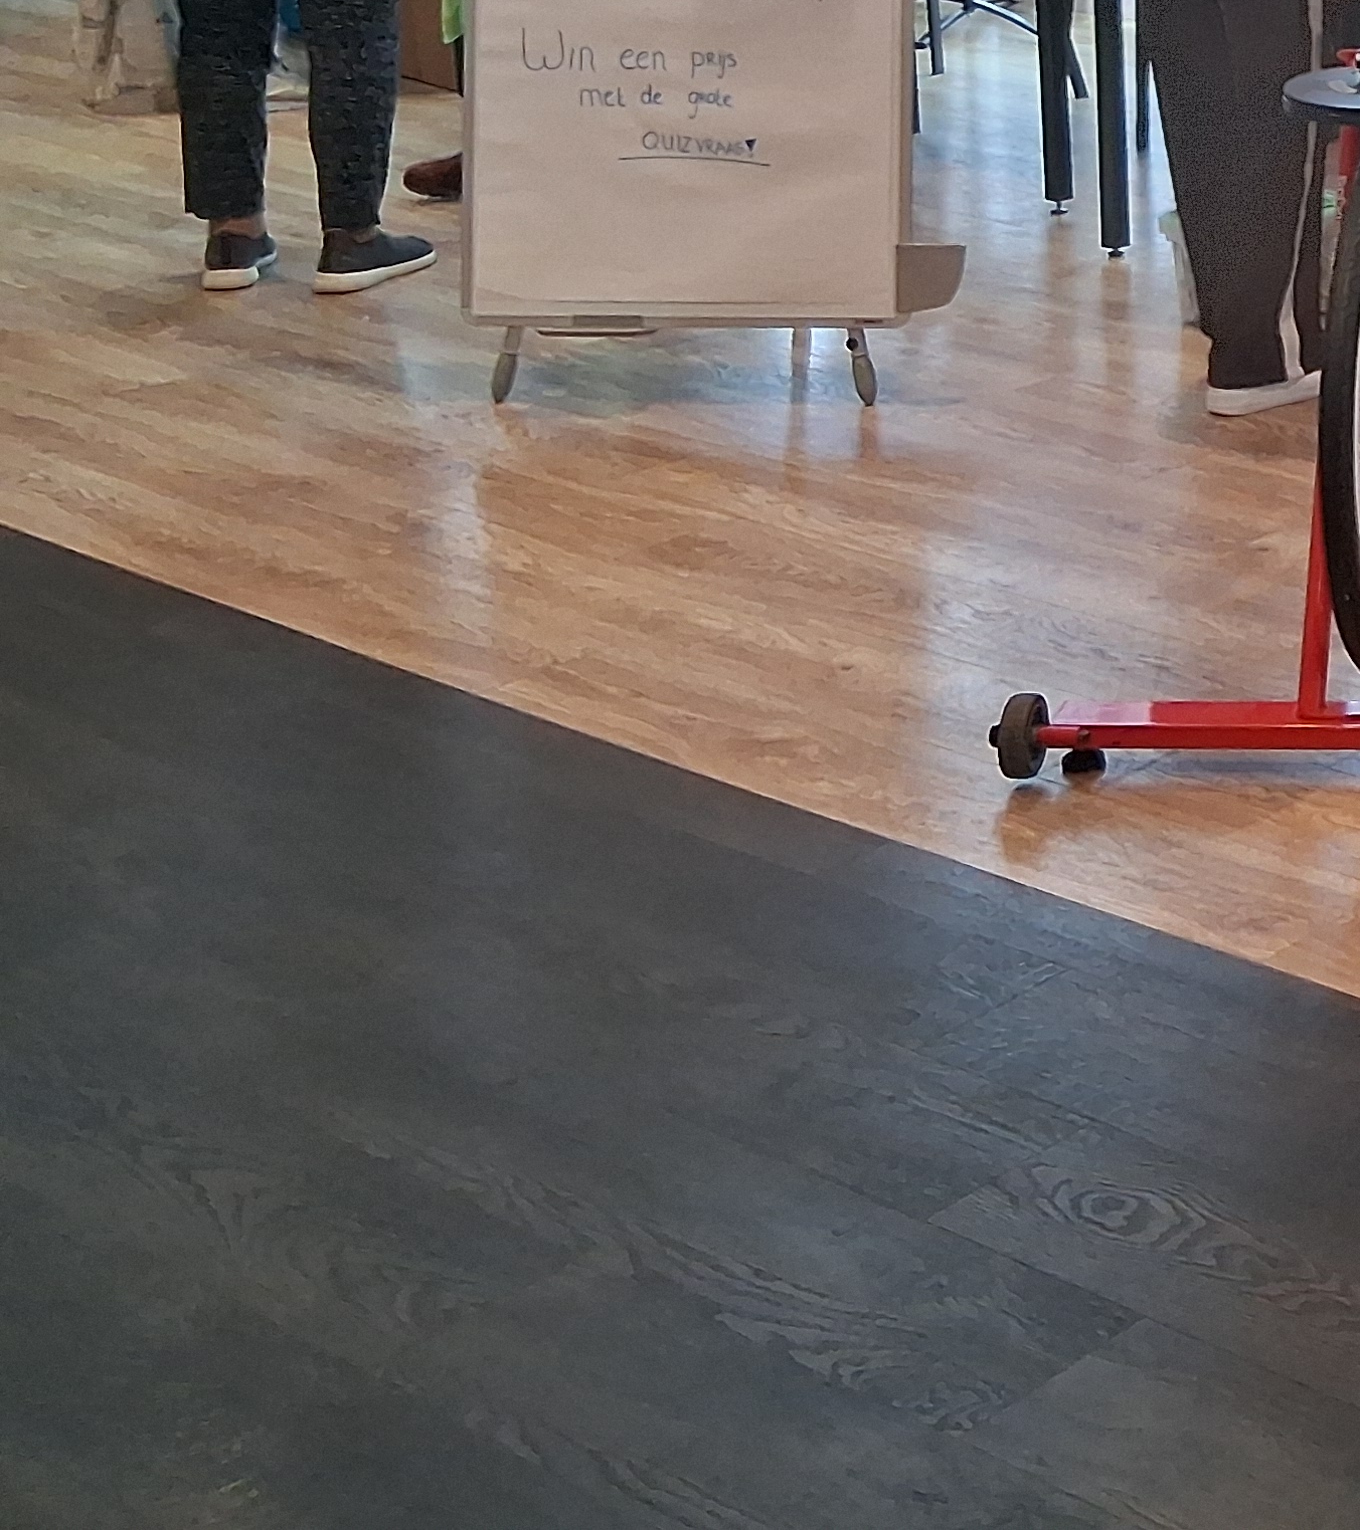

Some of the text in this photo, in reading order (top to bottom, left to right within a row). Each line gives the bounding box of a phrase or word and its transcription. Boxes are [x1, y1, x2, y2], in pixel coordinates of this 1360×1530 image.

[521, 27, 596, 73] Win
[619, 48, 668, 72] een
[579, 86, 626, 108] met
[640, 83, 662, 106] de
